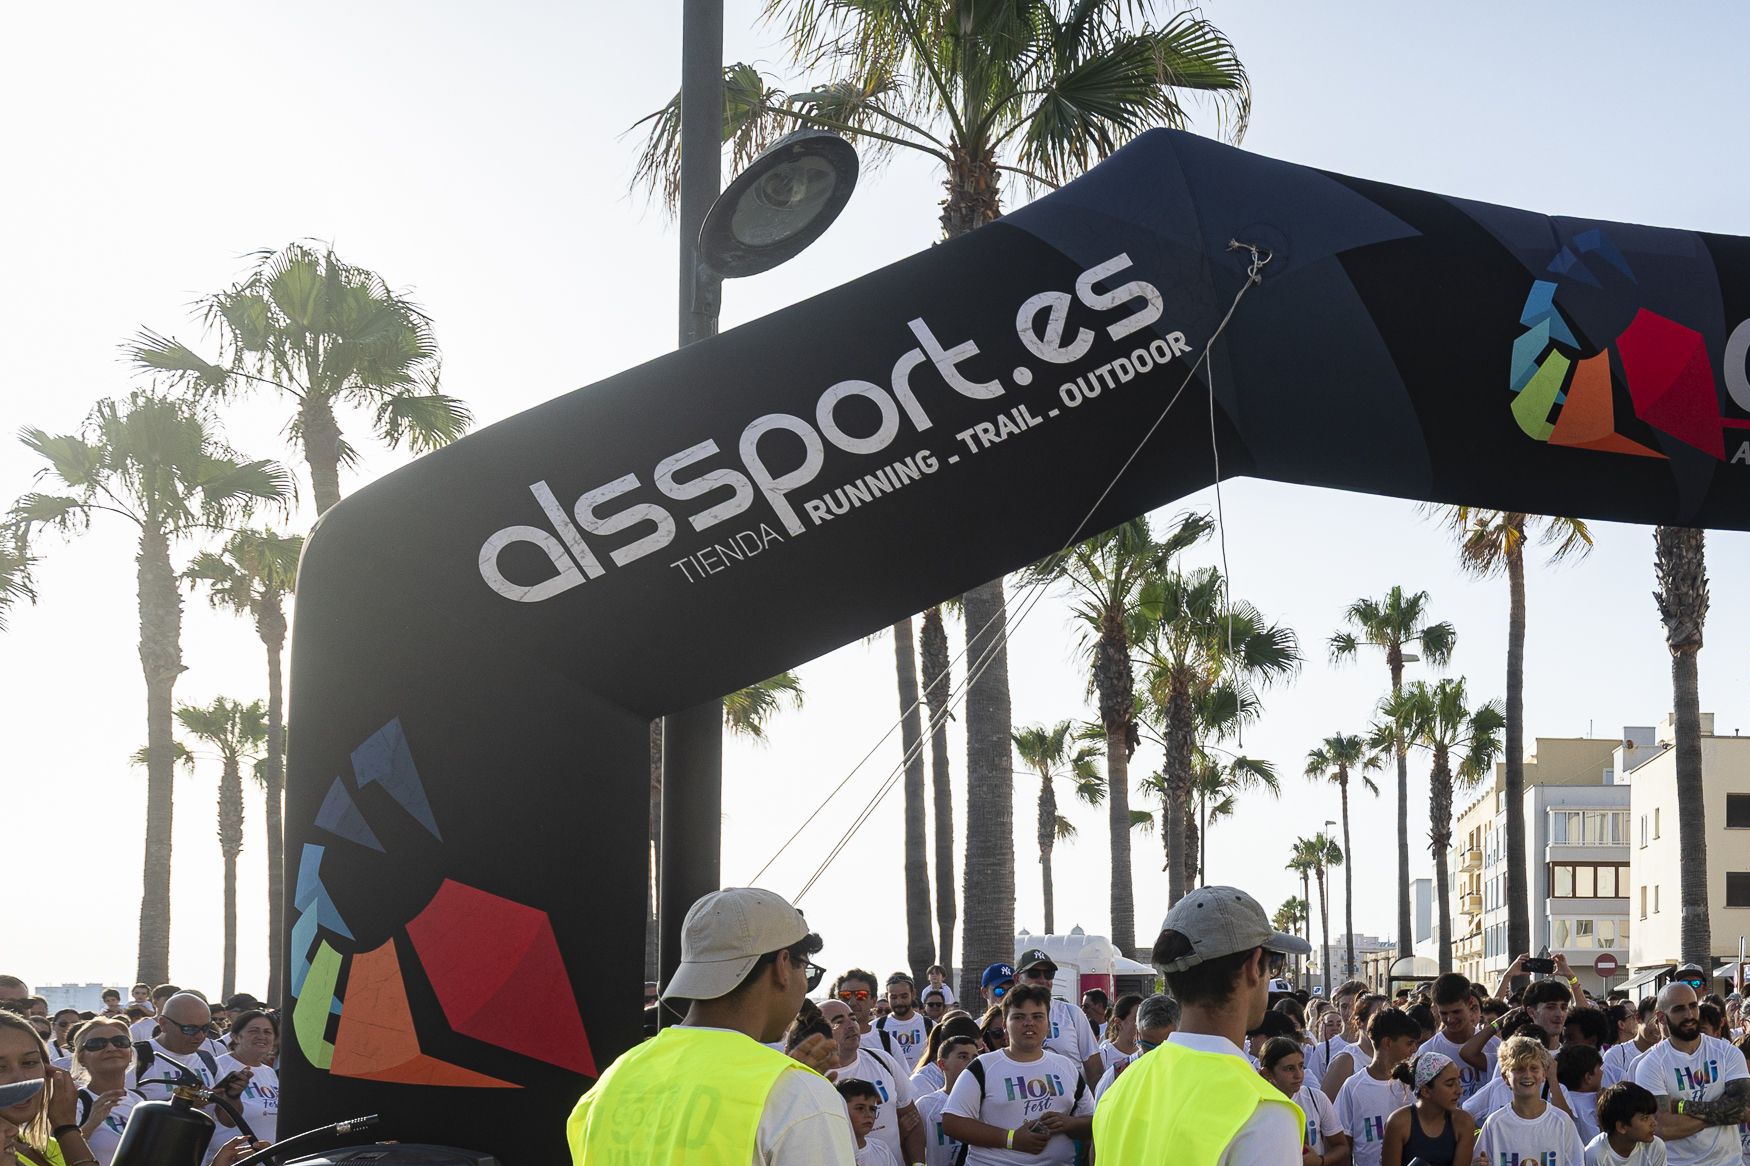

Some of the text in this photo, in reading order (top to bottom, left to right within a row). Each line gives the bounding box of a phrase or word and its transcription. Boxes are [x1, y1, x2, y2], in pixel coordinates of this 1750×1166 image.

[477, 252, 1164, 603] alssport.es
[670, 521, 785, 584] TIENDA
[803, 449, 940, 526] RUNNING
[955, 403, 1044, 456] TRAIL
[1058, 329, 1193, 409] OUTDOOR
[1004, 1074, 1065, 1101] Holi
[1024, 1098, 1052, 1116] Fest
